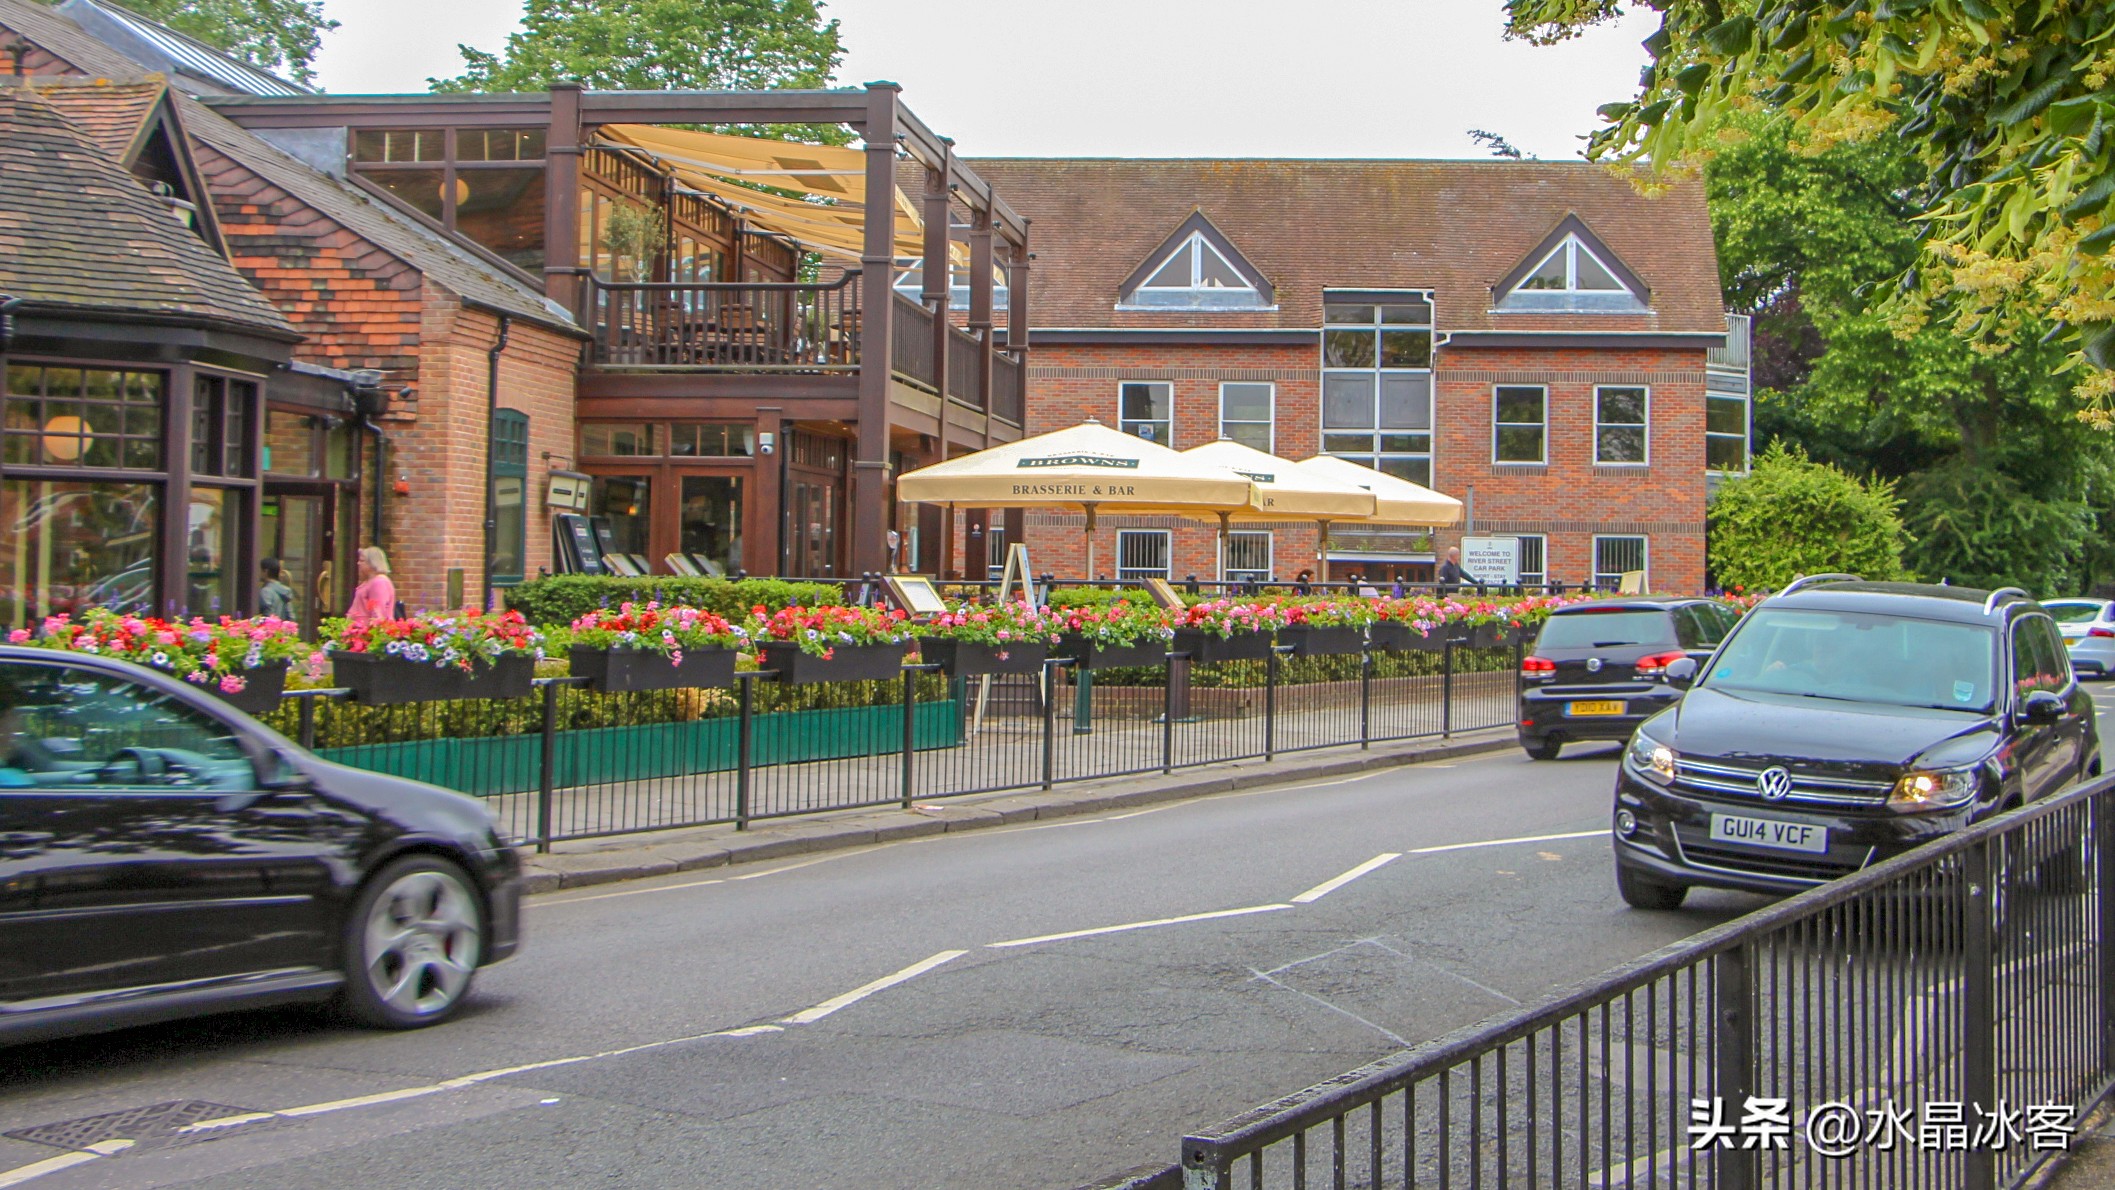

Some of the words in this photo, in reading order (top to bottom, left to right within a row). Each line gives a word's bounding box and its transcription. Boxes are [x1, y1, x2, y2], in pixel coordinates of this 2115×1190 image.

[1029, 457, 1128, 466] BROWNS
[1012, 484, 1086, 495] BRASSERIE
[1092, 485, 1103, 495] &
[1108, 485, 1135, 496] BAR
[1724, 818, 1766, 840] GU14
[1774, 823, 1813, 845] VCF
